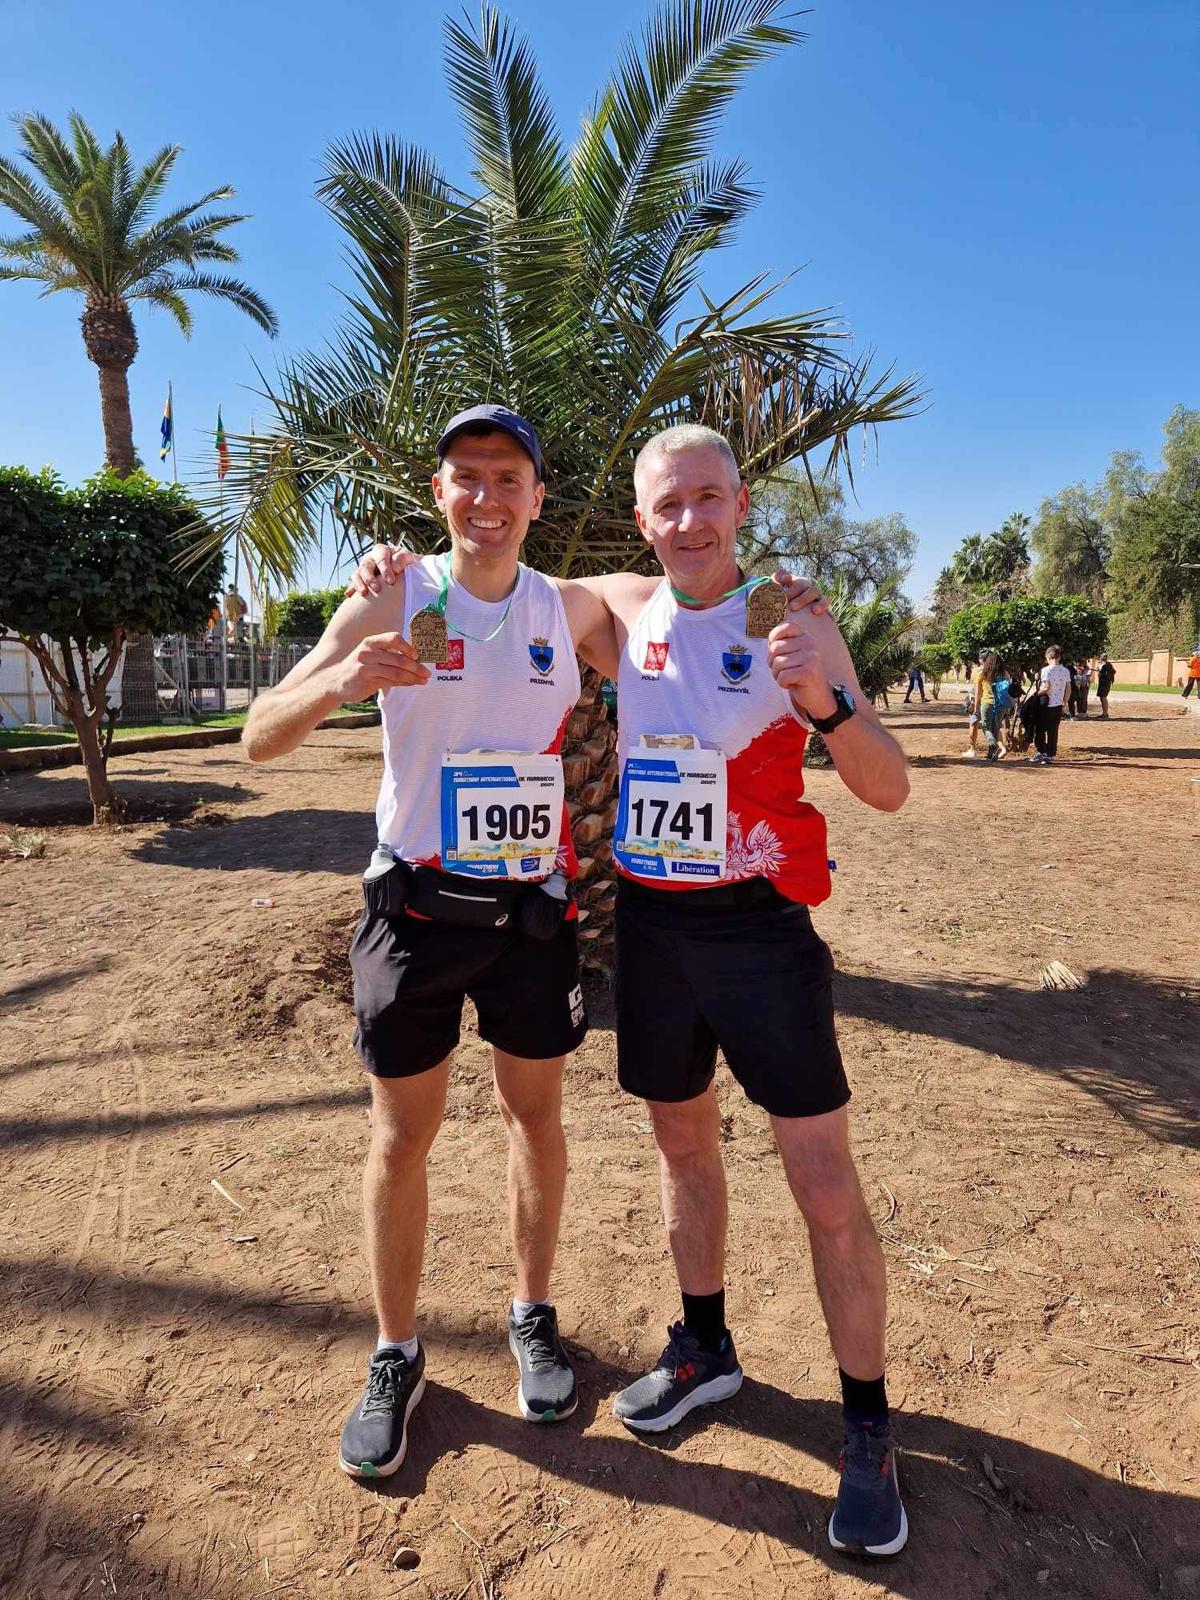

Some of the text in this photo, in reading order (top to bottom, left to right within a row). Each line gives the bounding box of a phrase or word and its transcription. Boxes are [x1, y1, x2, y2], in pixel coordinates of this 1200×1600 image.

[461, 804, 551, 841] 1905
[631, 798, 713, 841] 1741
[675, 862, 715, 874] Libération
